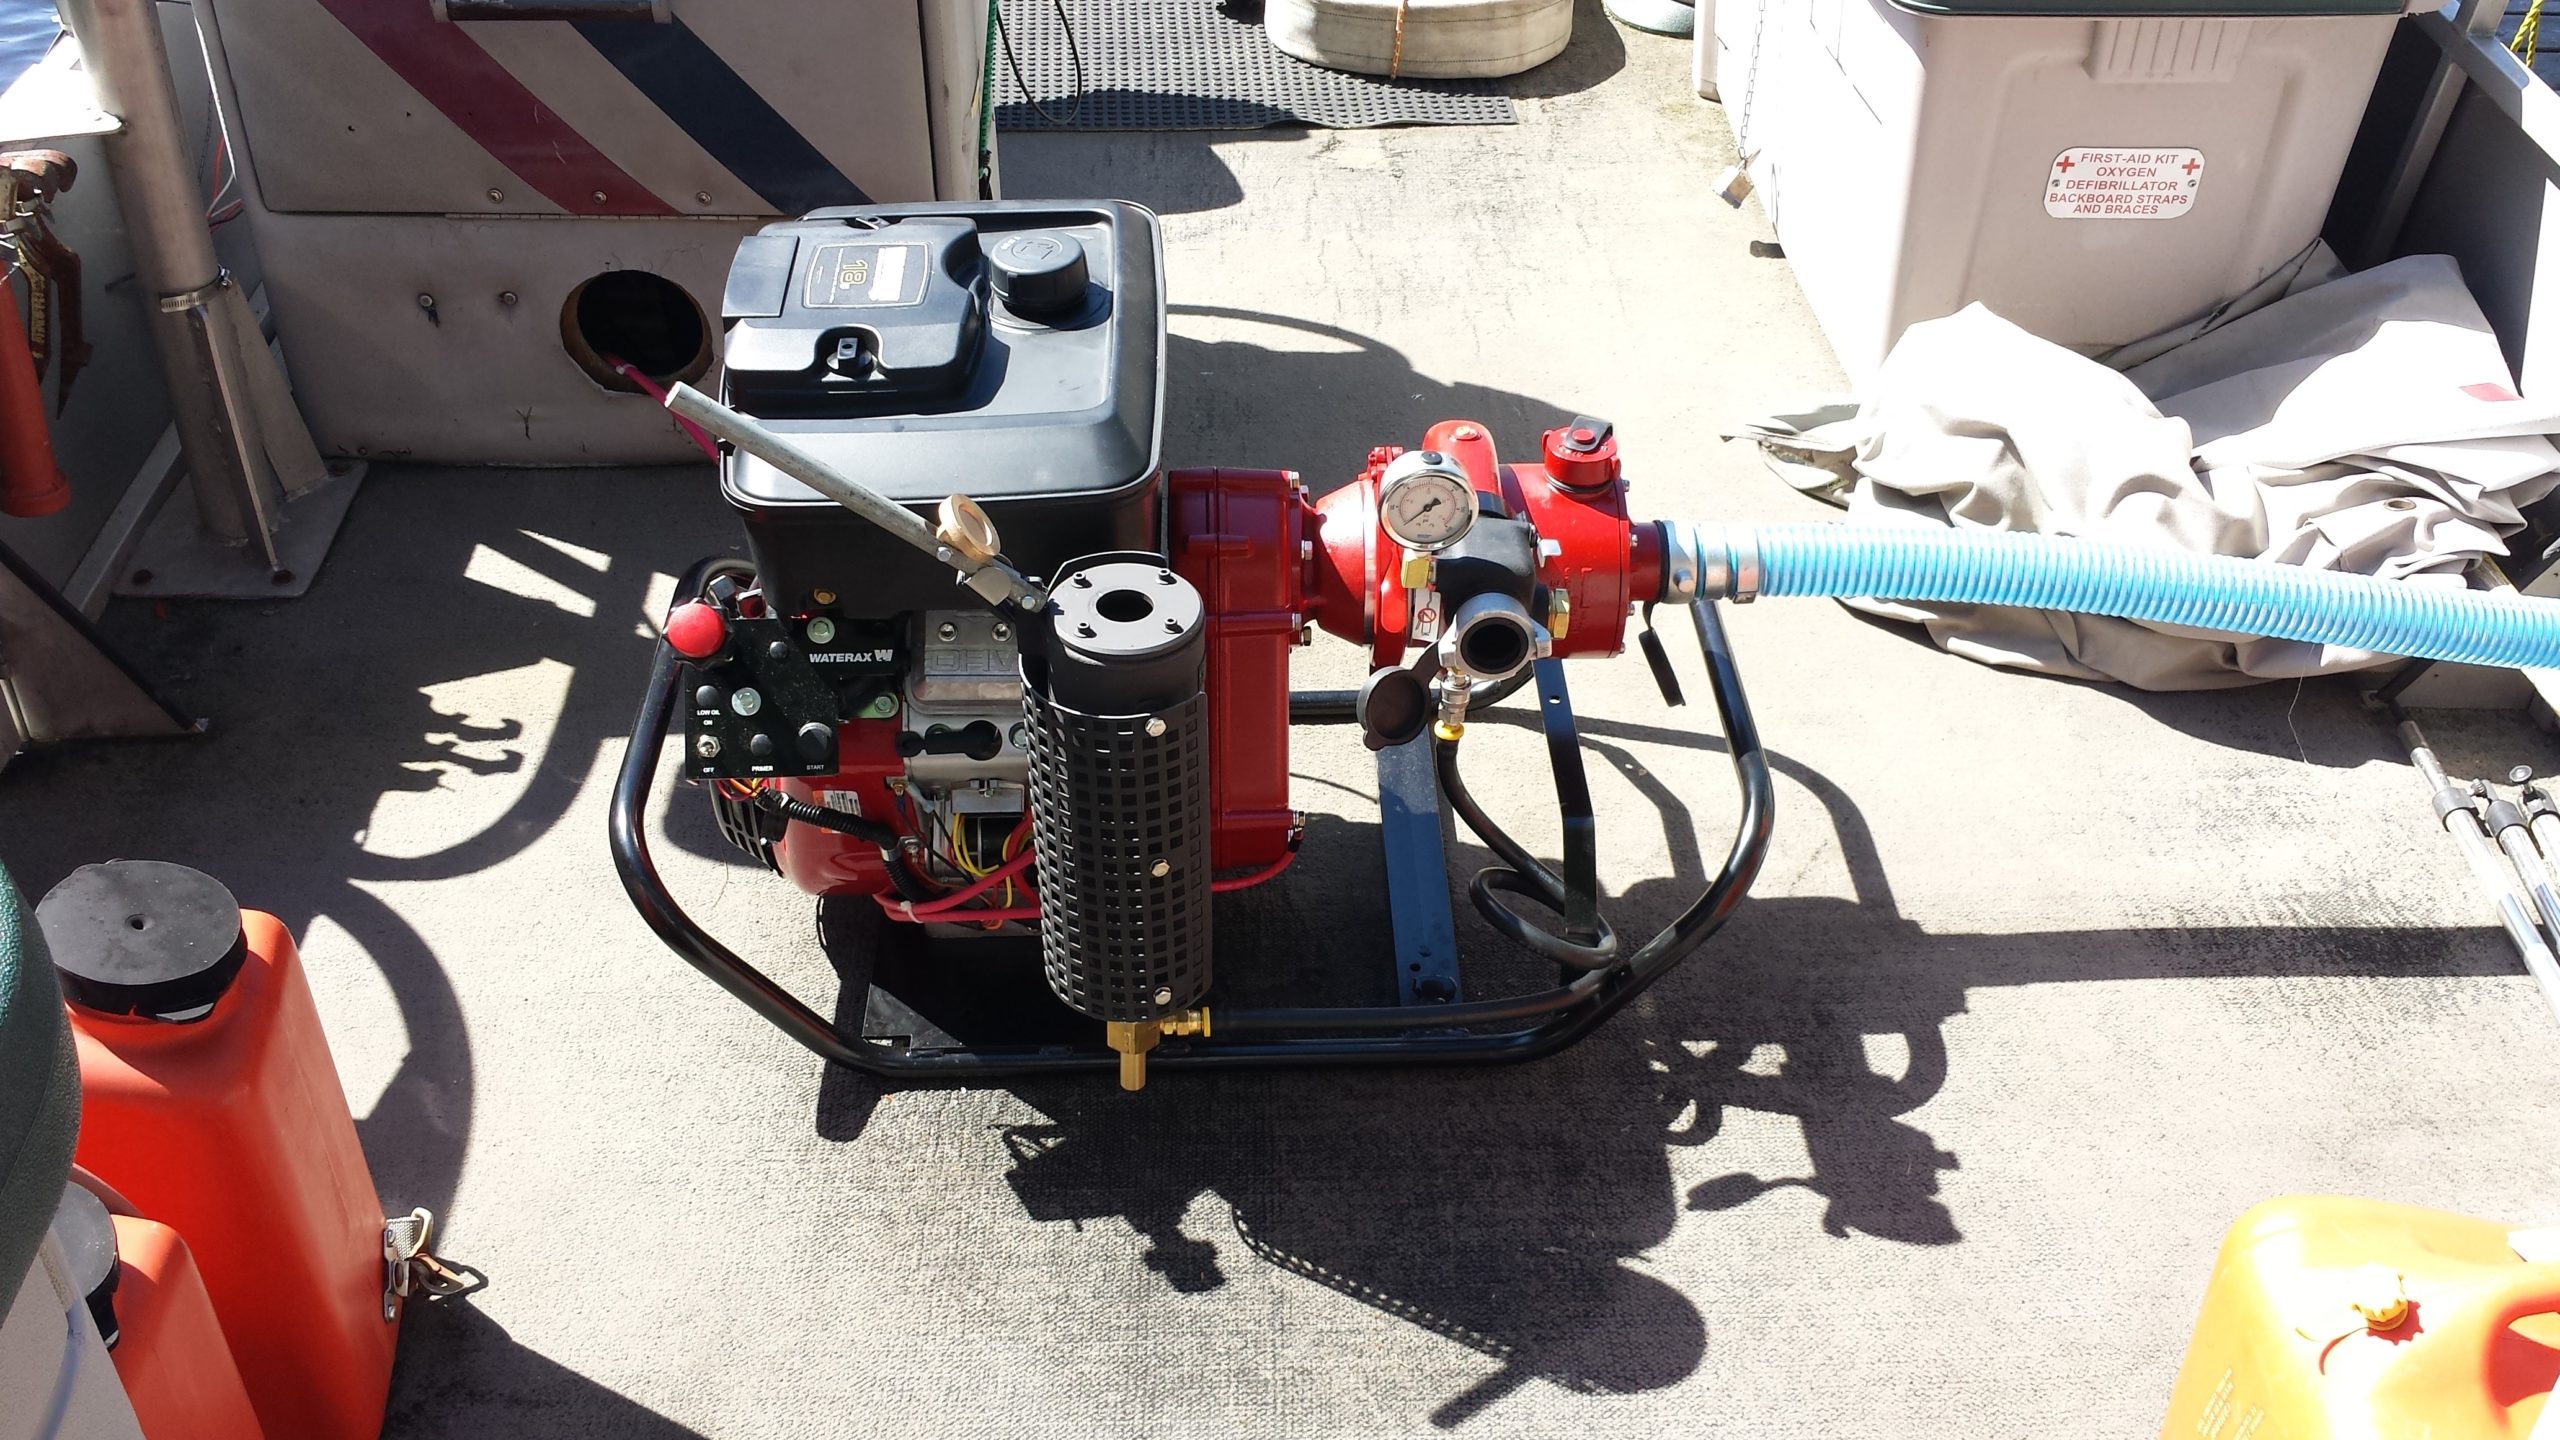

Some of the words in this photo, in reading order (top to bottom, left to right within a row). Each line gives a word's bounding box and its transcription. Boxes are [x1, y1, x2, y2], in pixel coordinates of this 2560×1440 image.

[2080, 153, 2151, 164] FIRST-AID
[2155, 154, 2179, 164] KIT
[2096, 167, 2157, 177] OXYGEN
[2066, 180, 2178, 191] DEFIBRILLATOR
[2049, 193, 2133, 204] BACKBOARD
[2136, 194, 2188, 204] STRAPS
[2073, 204, 2101, 213] AND
[2104, 205, 2159, 214] BRACES
[840, 259, 868, 285] 18
[809, 653, 872, 663] WATERAX
